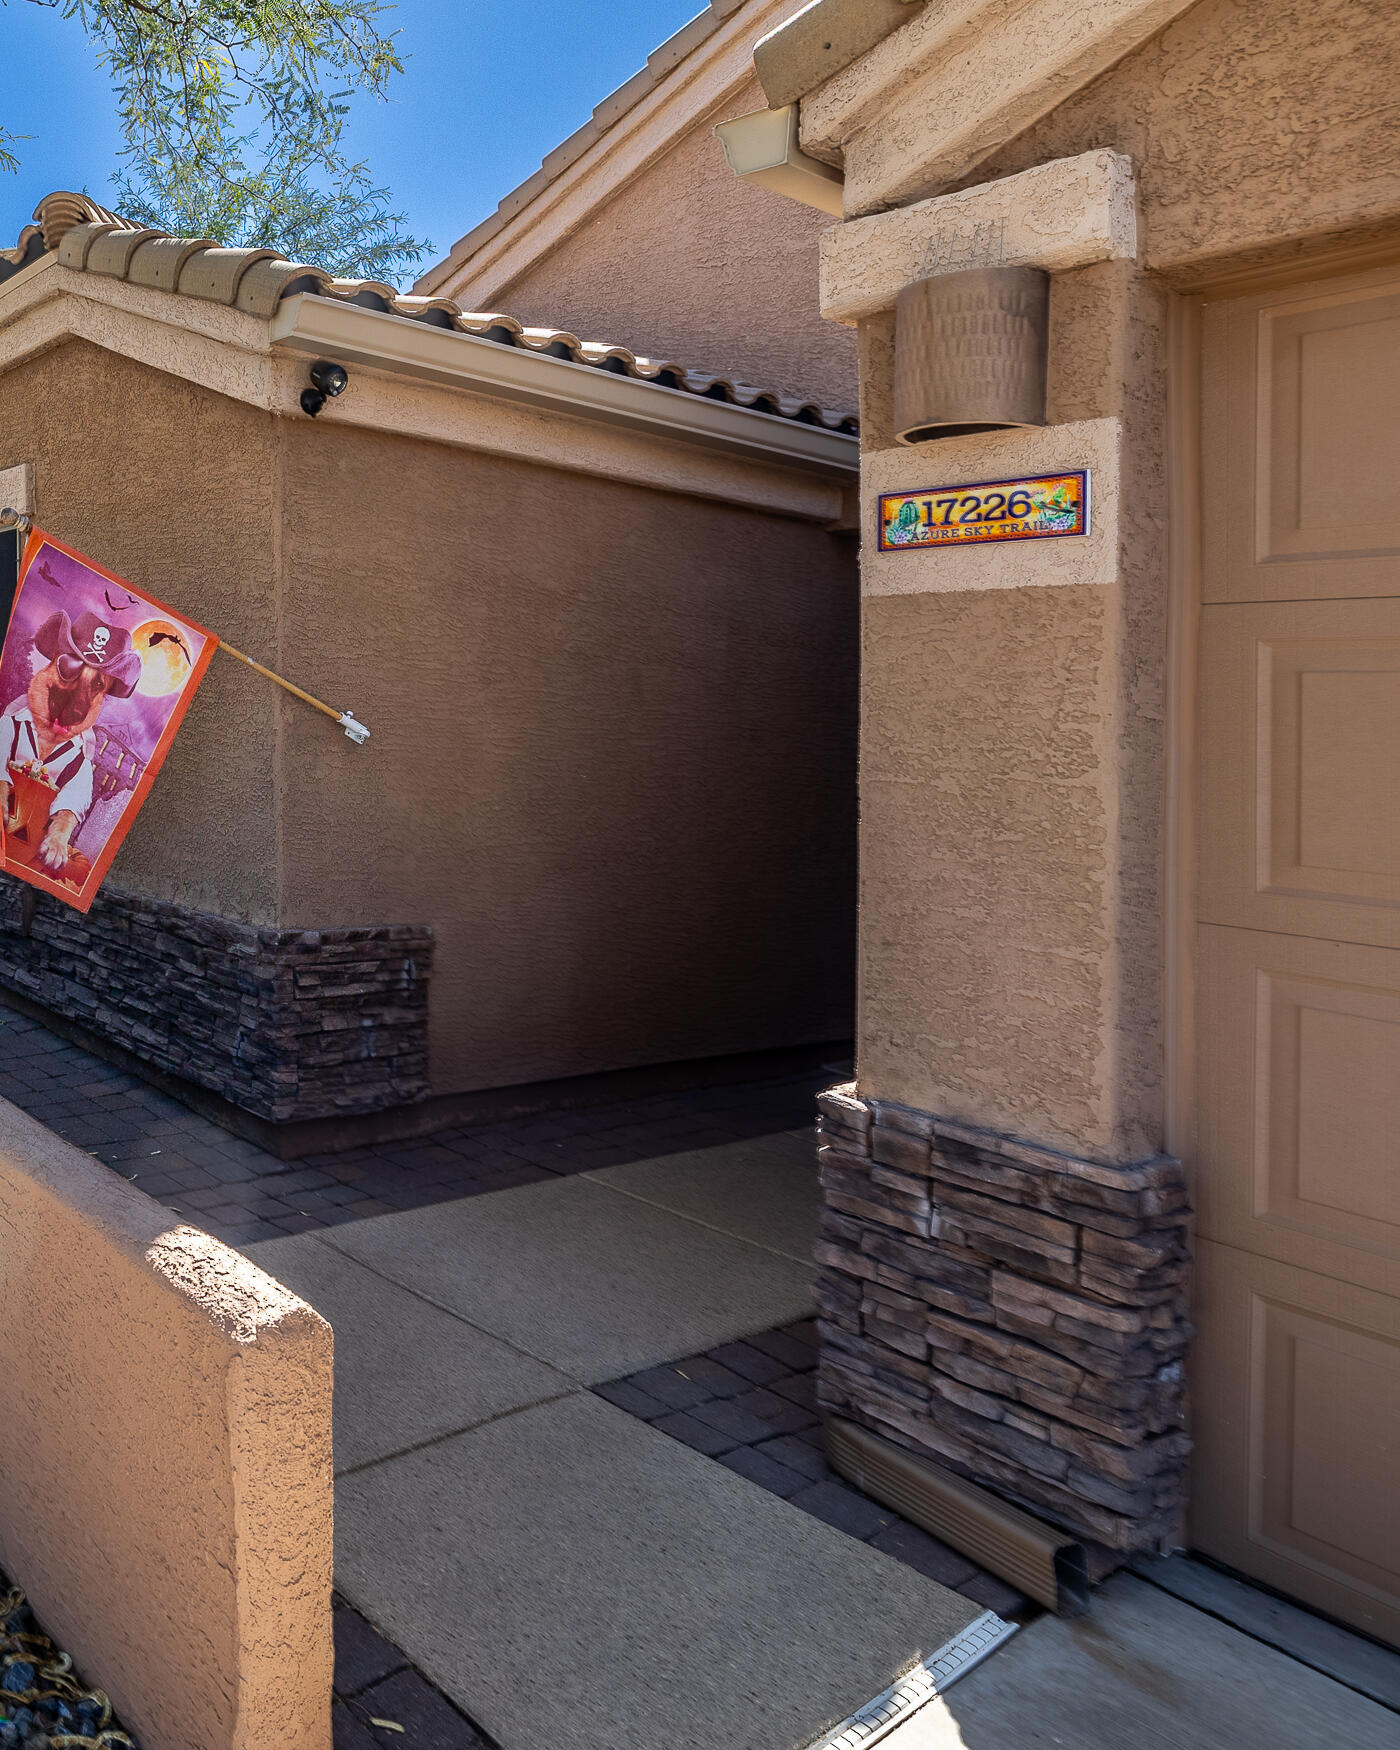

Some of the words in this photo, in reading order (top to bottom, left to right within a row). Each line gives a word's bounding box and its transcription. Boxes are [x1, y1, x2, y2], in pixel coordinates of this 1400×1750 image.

[922, 490, 1032, 527] 17226
[910, 528, 960, 542] AZURE
[964, 525, 994, 538] SKY
[999, 519, 1050, 535] TRAIL
